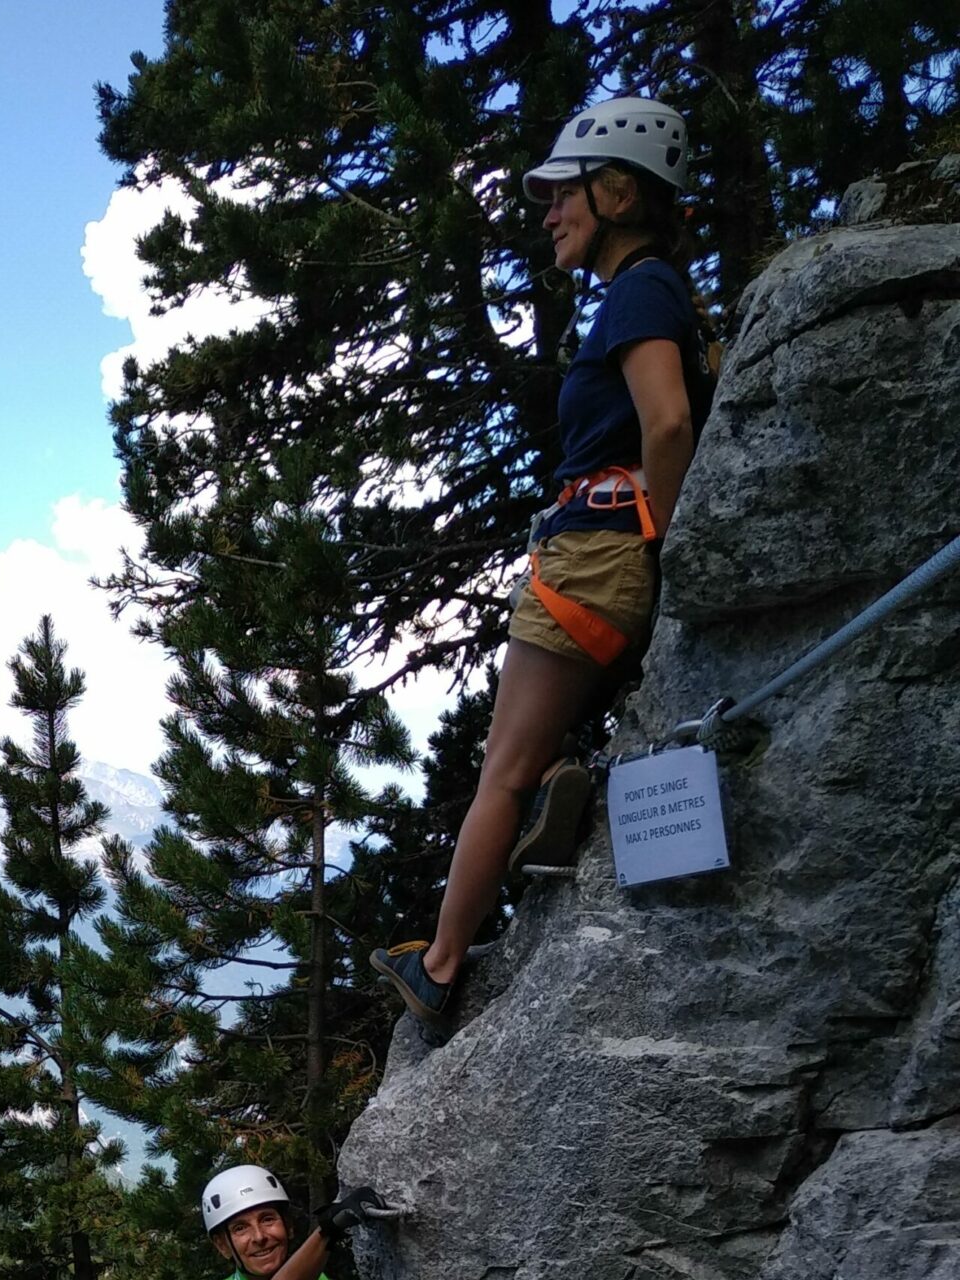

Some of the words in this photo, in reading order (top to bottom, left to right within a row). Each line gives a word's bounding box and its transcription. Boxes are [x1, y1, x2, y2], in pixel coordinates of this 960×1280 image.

[624, 788, 645, 803] PONT
[647, 785, 659, 798] DE
[660, 777, 688, 795] SINGE
[618, 807, 659, 826] LONGUEUR
[660, 804, 666, 816] 8
[668, 796, 705, 814] METRES
[625, 831, 642, 845] MAX
[643, 830, 648, 842] 2
[649, 818, 702, 840] PERSONNES
